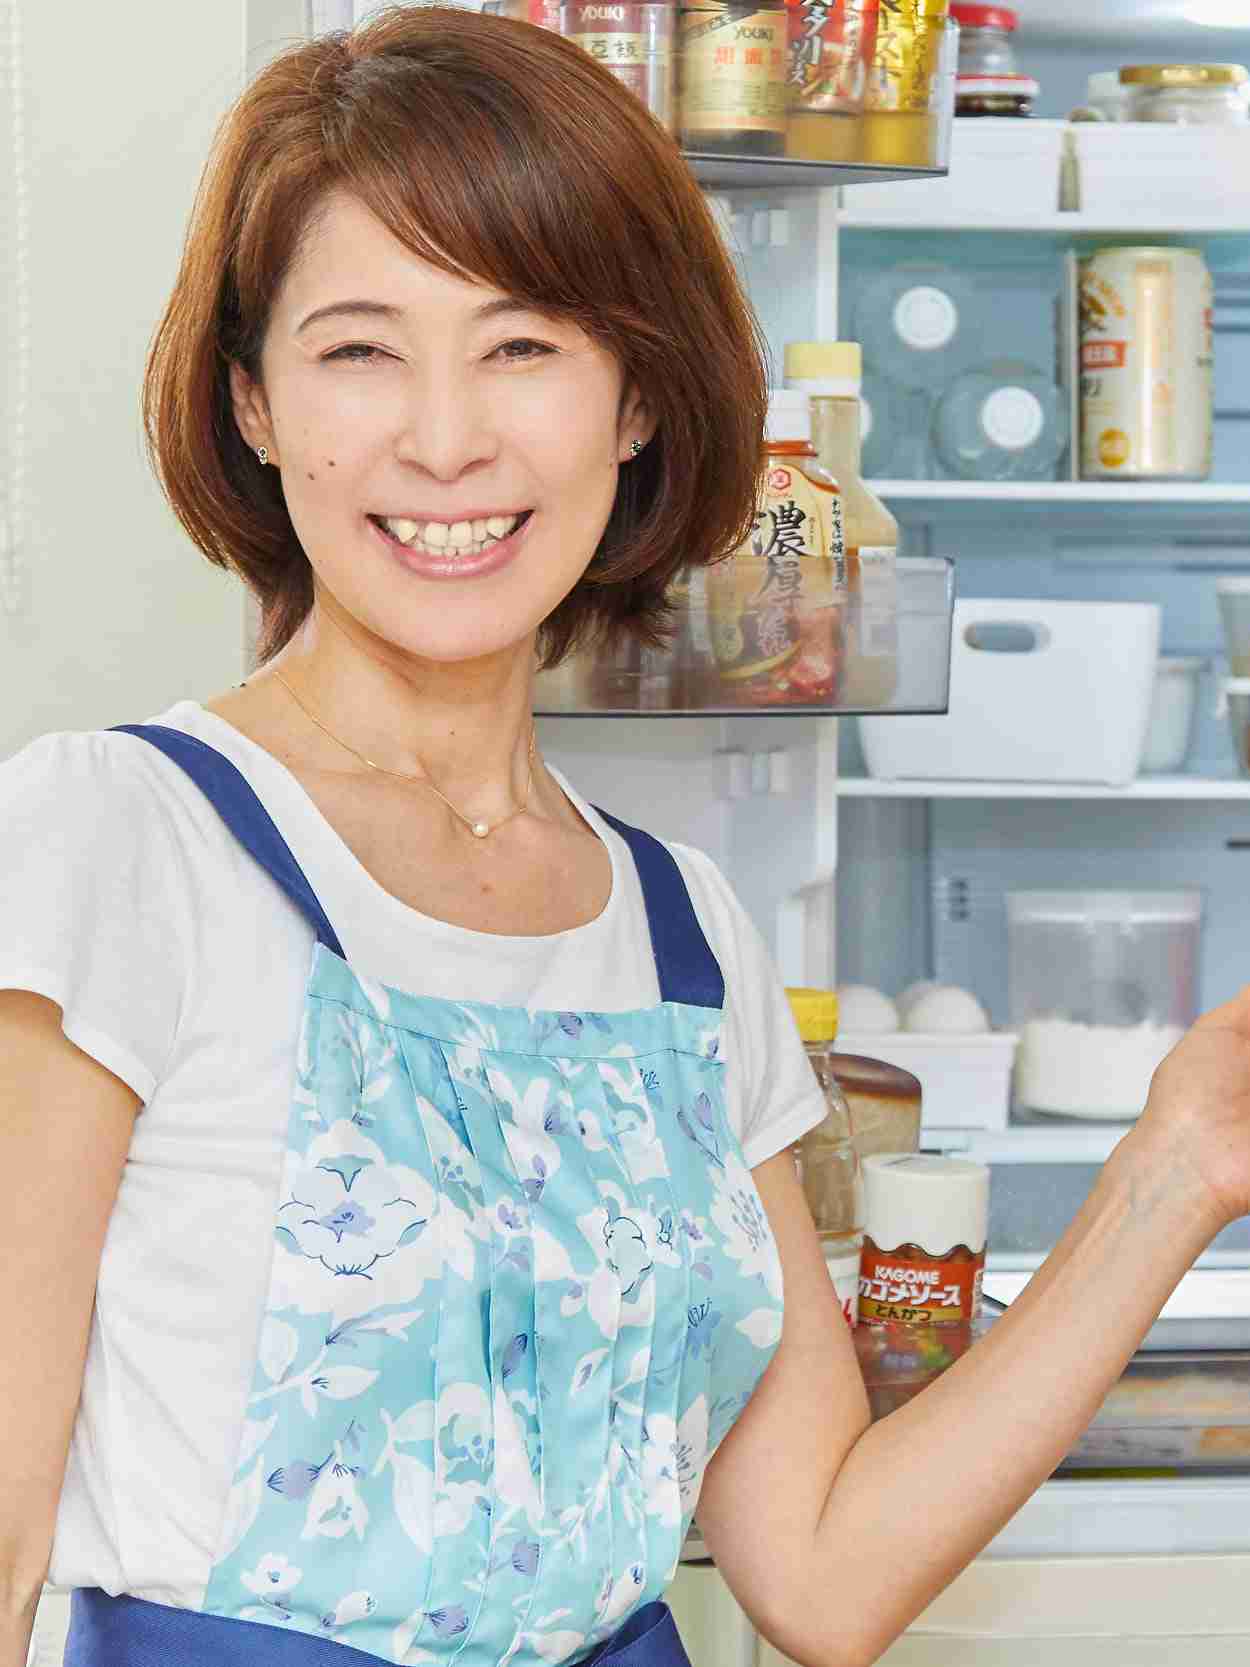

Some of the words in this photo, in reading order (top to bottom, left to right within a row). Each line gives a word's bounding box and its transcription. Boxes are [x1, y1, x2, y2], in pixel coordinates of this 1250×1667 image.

[874, 1265, 941, 1285] KAGOME
[875, 1304, 932, 1321] とんかつ
